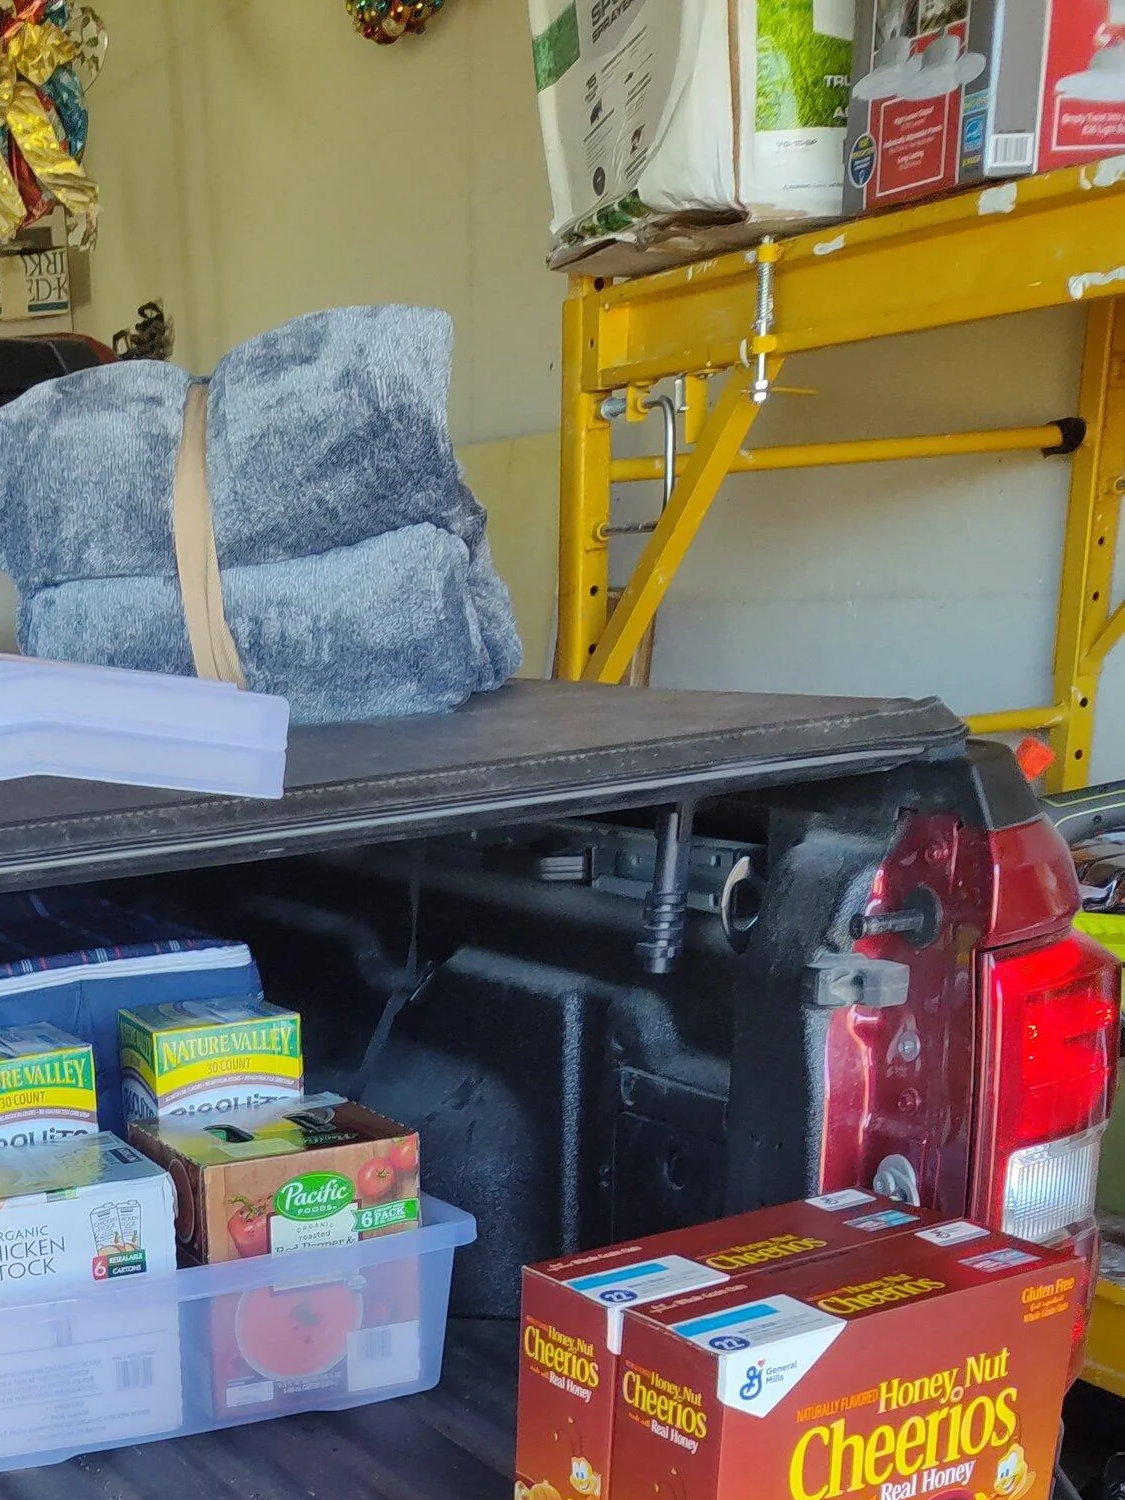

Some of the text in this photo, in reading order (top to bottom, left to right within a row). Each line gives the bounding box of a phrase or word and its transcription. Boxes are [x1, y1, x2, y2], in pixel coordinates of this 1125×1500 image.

[162, 1035, 229, 1073] NATURE
[230, 1025, 293, 1056] VALLEY
[23, 1056, 87, 1088] VALLEY
[206, 1057, 252, 1075] 30 COUNT
[0, 1090, 46, 1109] 30 COUNT
[281, 1179, 350, 1211] Pacific
[297, 1206, 333, 1216] FOODS
[296, 1222, 334, 1234] ORGANIC
[361, 1206, 406, 1228] 6 PACK
[299, 1230, 331, 1243] roasted
[95, 1261, 142, 1277] 6 CARTONS
[109, 1253, 144, 1264] RESEALABLE
[706, 1237, 828, 1271] Cheerios
[817, 1278, 947, 1314] Cheerios
[1021, 1283, 1053, 1305] Gluten
[1054, 1277, 1076, 1296] Free
[525, 1325, 599, 1388] Cheerios
[548, 1325, 595, 1358] Honey Nut
[765, 1374, 784, 1384] Mills
[766, 1360, 798, 1376] General
[549, 1370, 566, 1389] Real
[566, 1377, 593, 1404] Honey
[651, 1371, 703, 1407] Honey Nut
[795, 1347, 1010, 1424] NATURALLY FLAVORED Honey Nut
[623, 1371, 707, 1439] Cheerios
[651, 1420, 699, 1455] Real Honey
[921, 1460, 976, 1494] Honey
